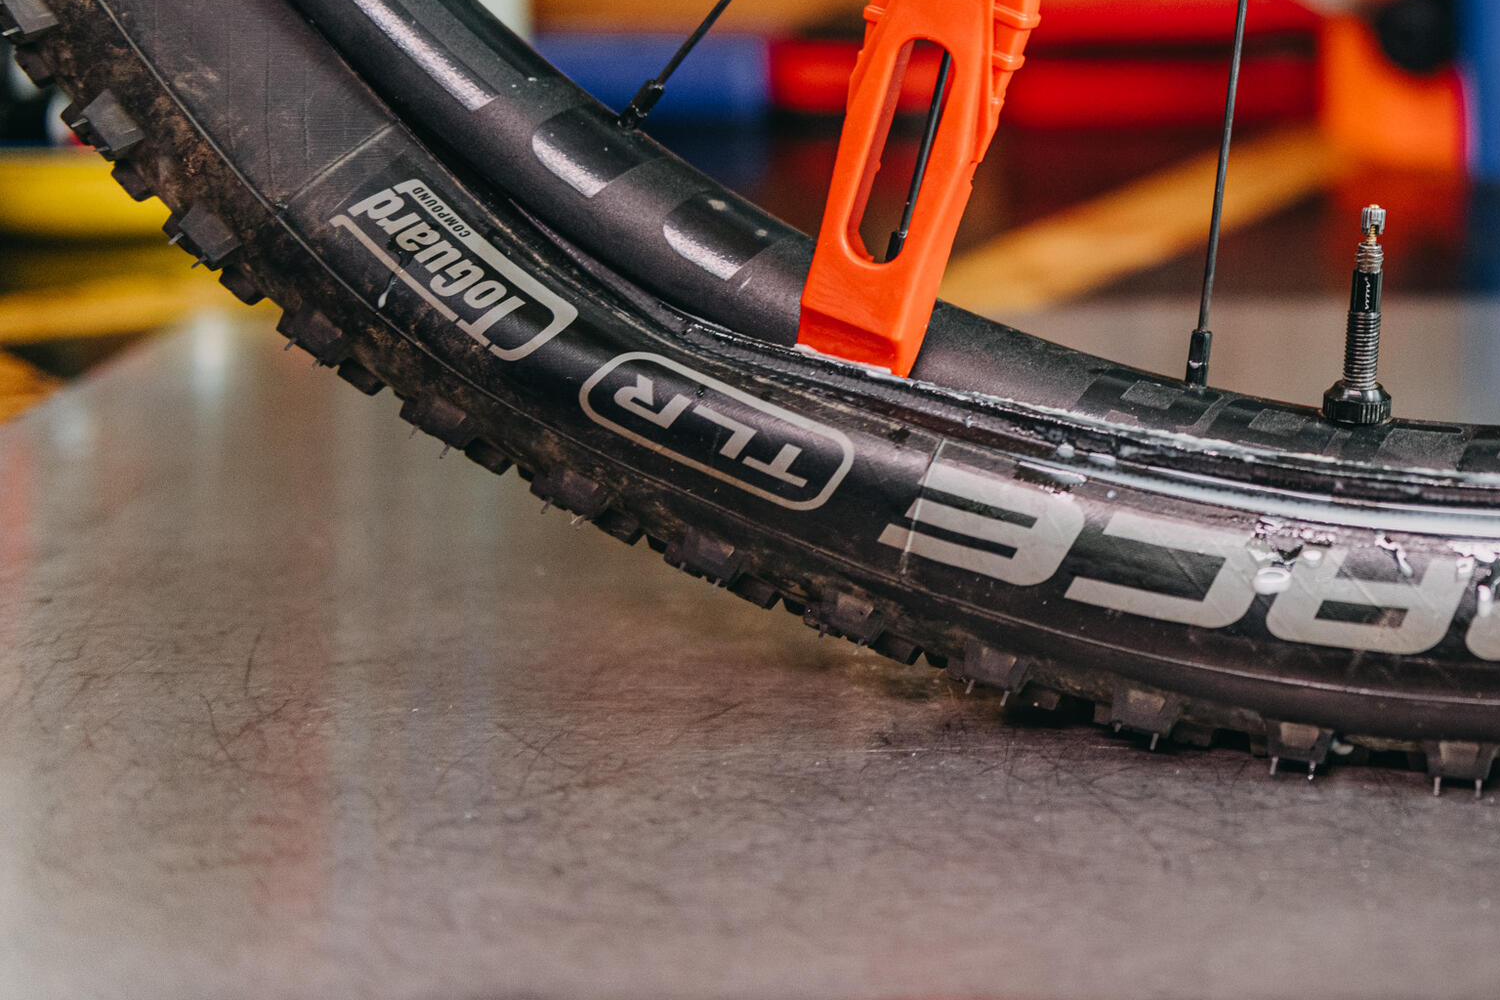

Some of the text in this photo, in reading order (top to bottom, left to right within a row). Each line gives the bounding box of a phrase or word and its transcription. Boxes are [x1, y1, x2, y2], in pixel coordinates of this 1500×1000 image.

[348, 188, 527, 347] ToGuard
[412, 187, 471, 238] COMPOUND
[613, 373, 808, 488] TLR
